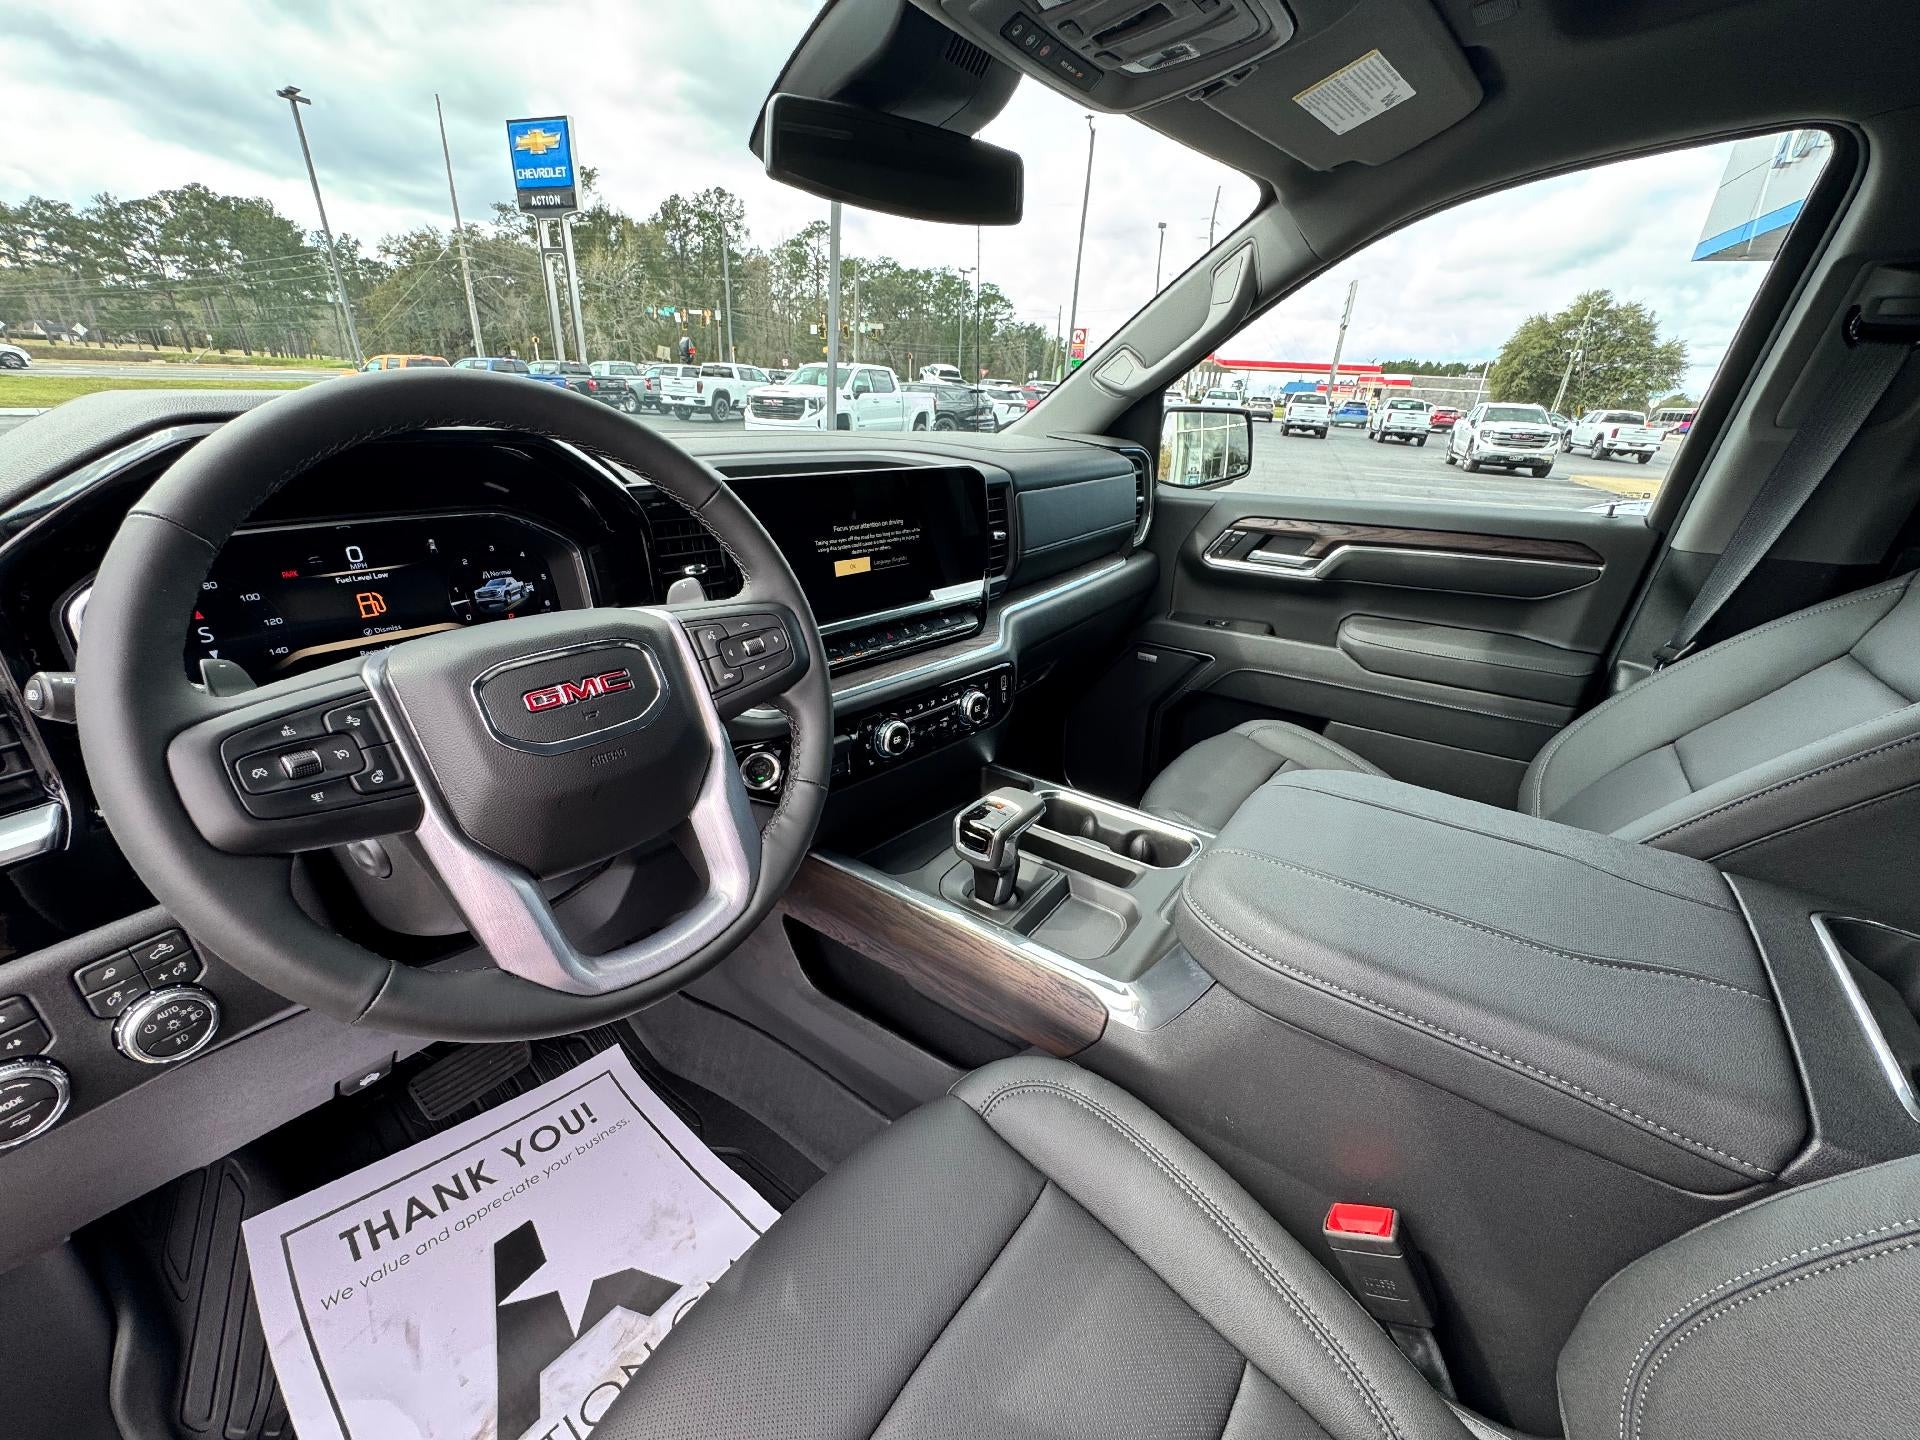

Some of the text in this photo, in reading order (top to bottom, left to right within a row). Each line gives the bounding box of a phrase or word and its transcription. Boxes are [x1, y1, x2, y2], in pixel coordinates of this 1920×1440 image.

[517, 167, 566, 179] CHEVROLET
[531, 195, 560, 205] ACTION
[860, 521, 881, 529] attention
[350, 562, 367, 570] MPH
[281, 570, 299, 578] PARK
[490, 568, 512, 577] Normal
[335, 572, 388, 584] Fuel Level Low
[203, 581, 217, 590] 80
[240, 593, 260, 602] 100
[264, 617, 283, 626] 120
[374, 625, 402, 633] Dismiss
[198, 627, 214, 643] S
[269, 647, 288, 656] 140
[522, 668, 635, 713] GMC
[281, 728, 297, 736] RES
[591, 747, 627, 767] AIRBAG
[311, 792, 324, 802] SET
[157, 1006, 179, 1020] AUTO
[339, 1102, 598, 1262] THANK YOU!
[321, 1117, 630, 1310] We value and appreciate your business.
